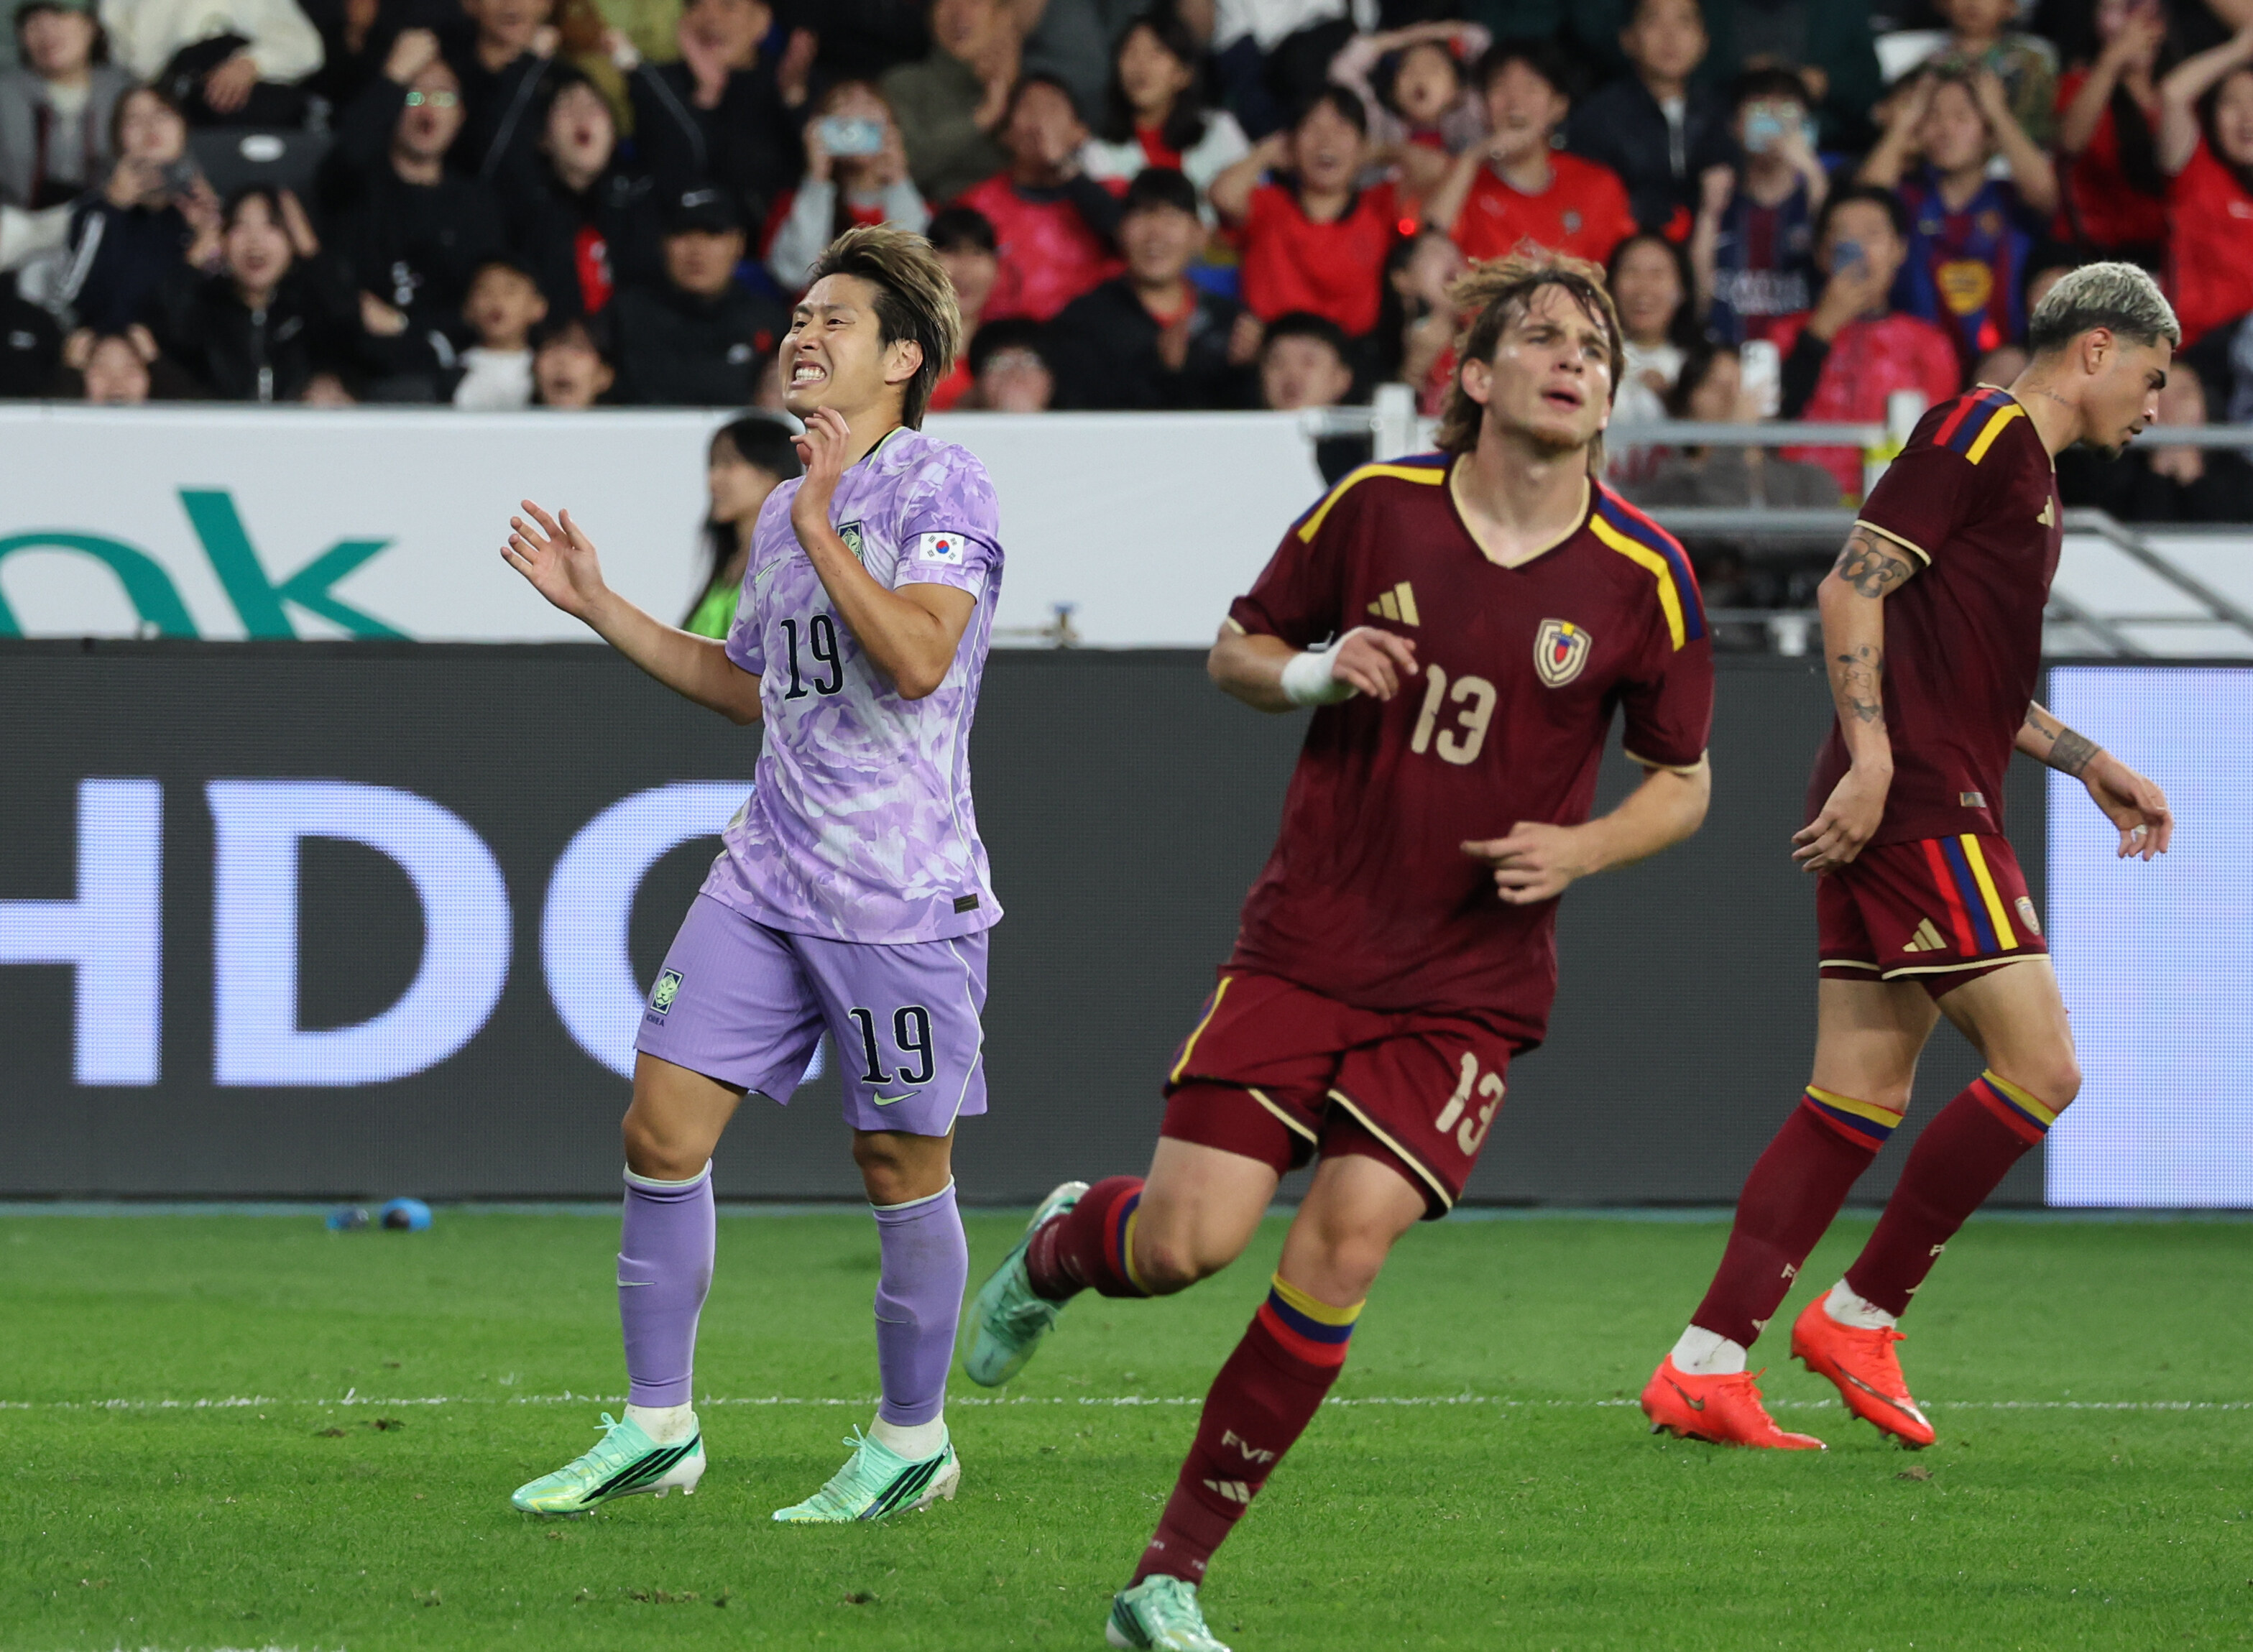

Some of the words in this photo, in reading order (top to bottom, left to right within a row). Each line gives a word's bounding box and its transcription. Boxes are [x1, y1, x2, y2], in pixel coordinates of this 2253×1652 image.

[780, 614, 844, 701] 19
[1411, 663, 1497, 765] 13
[849, 1005, 936, 1085] 19
[1435, 1051, 1506, 1156] 13
[1221, 1429, 1275, 1464] FVF
